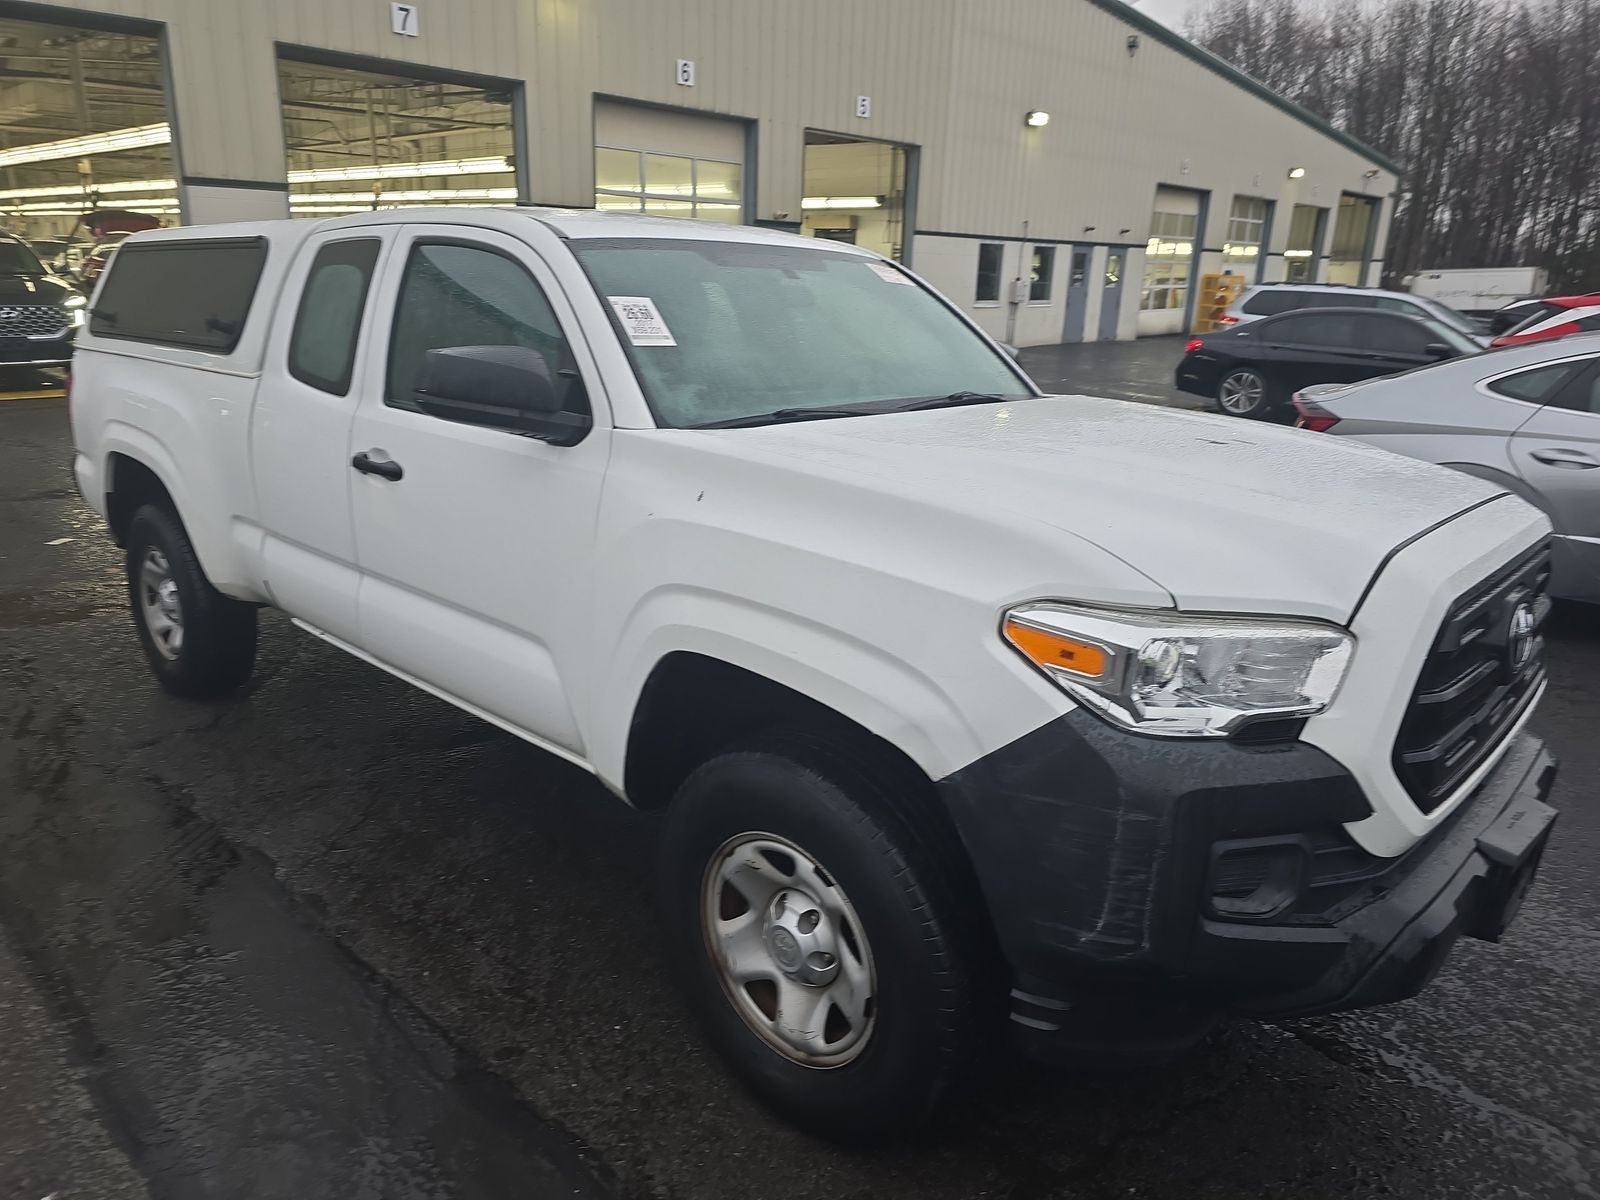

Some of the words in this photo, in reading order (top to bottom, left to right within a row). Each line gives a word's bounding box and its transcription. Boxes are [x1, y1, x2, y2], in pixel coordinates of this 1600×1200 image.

[397, 6, 410, 31] 7
[681, 62, 691, 82] 6
[859, 98, 867, 115] 5
